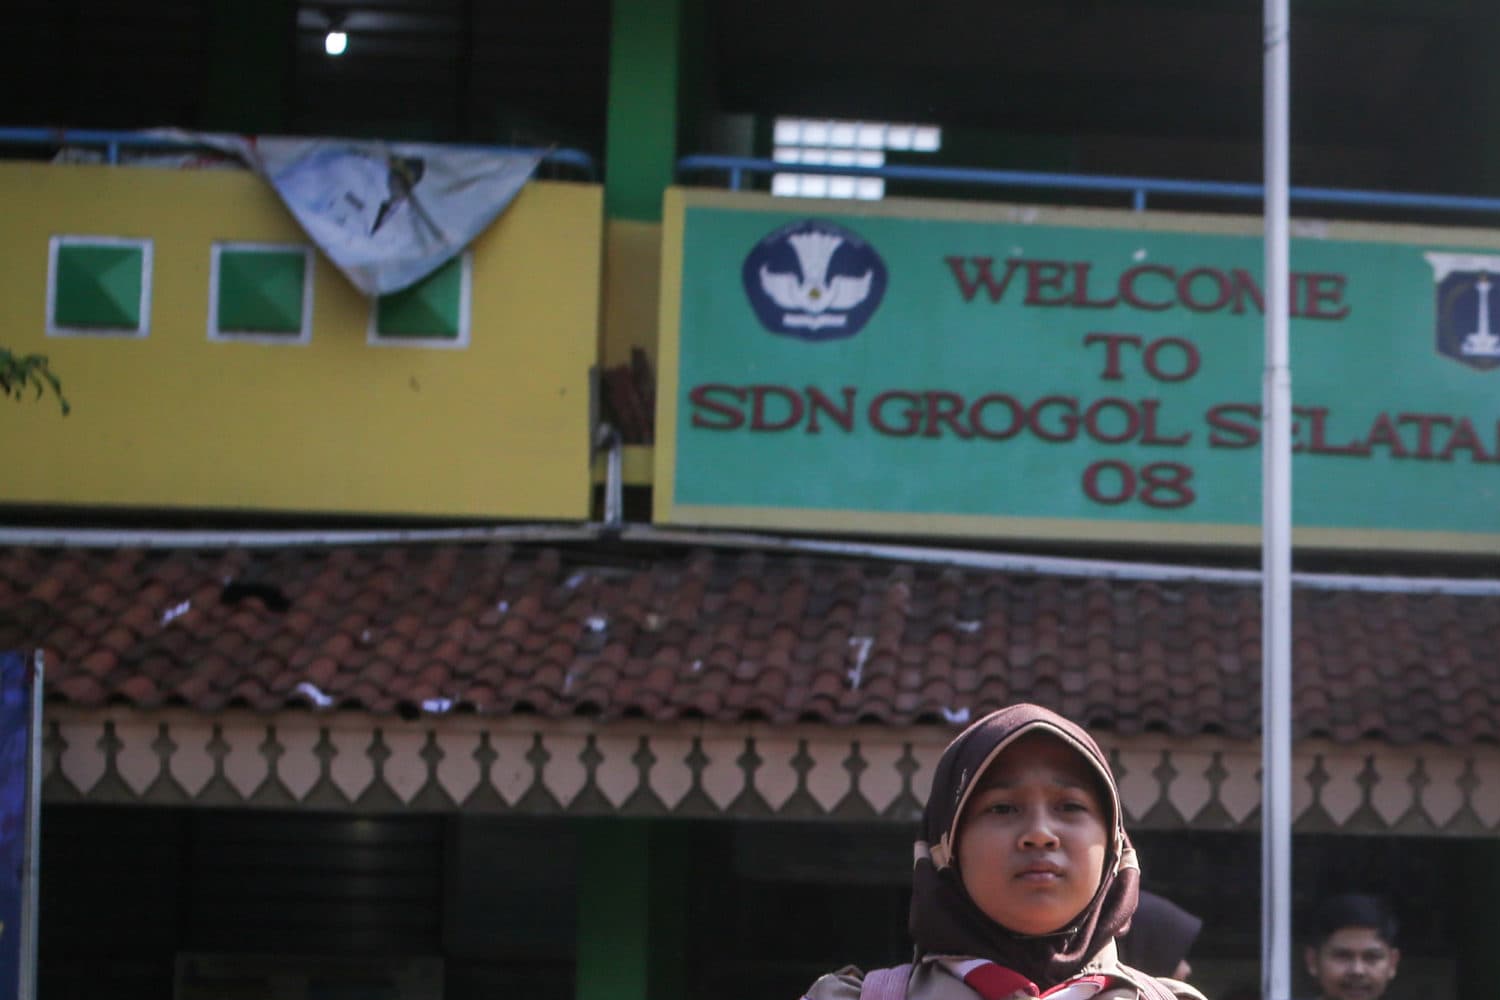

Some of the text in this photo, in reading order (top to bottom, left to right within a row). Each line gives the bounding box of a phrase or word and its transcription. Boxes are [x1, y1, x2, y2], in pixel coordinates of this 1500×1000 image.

[944, 256, 1351, 321] WELCOME
[1083, 332, 1200, 382] TO
[688, 383, 857, 434] SDN
[868, 390, 1192, 446] GROGOL
[1081, 459, 1196, 509] 08
